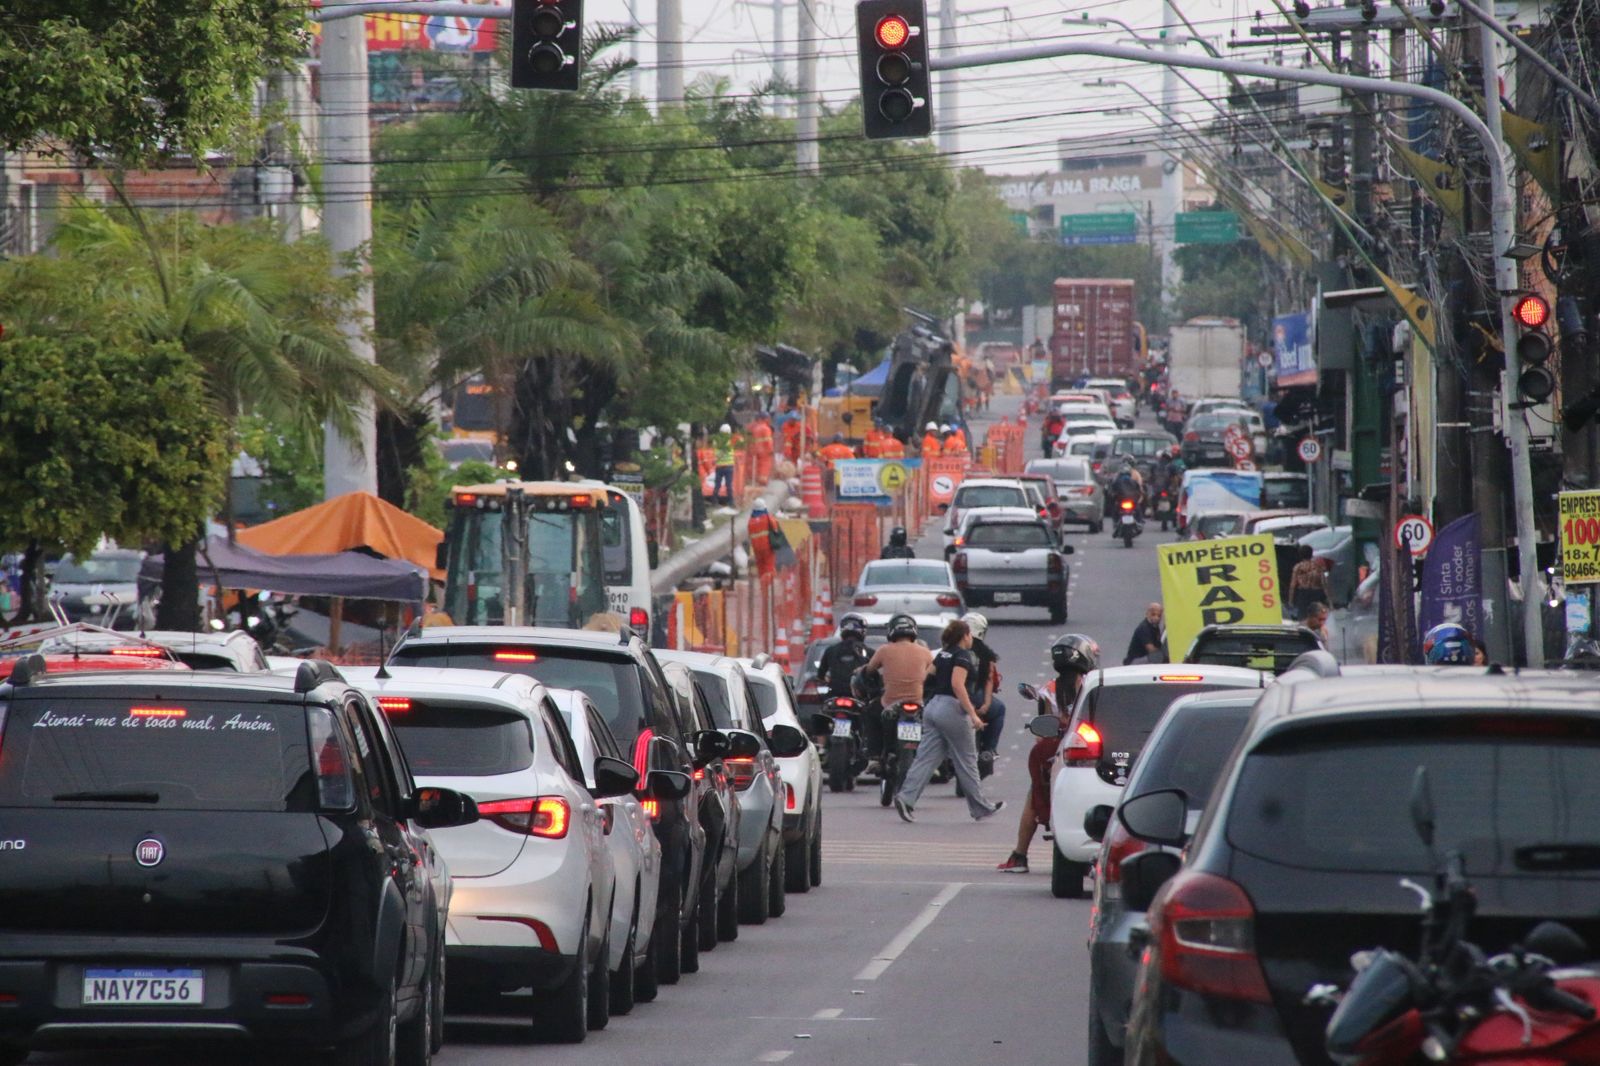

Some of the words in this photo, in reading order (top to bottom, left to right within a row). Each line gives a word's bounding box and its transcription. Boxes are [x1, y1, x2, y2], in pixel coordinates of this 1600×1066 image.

[1053, 179, 1084, 197] ANA
[1089, 175, 1141, 194] BRAGA
[1303, 442, 1317, 454] 60
[1402, 523, 1424, 541] 60
[1168, 543, 1265, 565] IMPÉRIO
[1453, 545, 1463, 581] poder
[1464, 541, 1474, 593] Yamaha
[1440, 562, 1452, 594] Sinta
[33, 710, 116, 727] Livrai-me
[121, 712, 140, 728] de
[145, 714, 177, 728] todo
[182, 715, 215, 730] mal.
[221, 713, 276, 731] Amém.
[141, 847, 158, 860] FIAT
[93, 979, 190, 1000] NAY7C56
